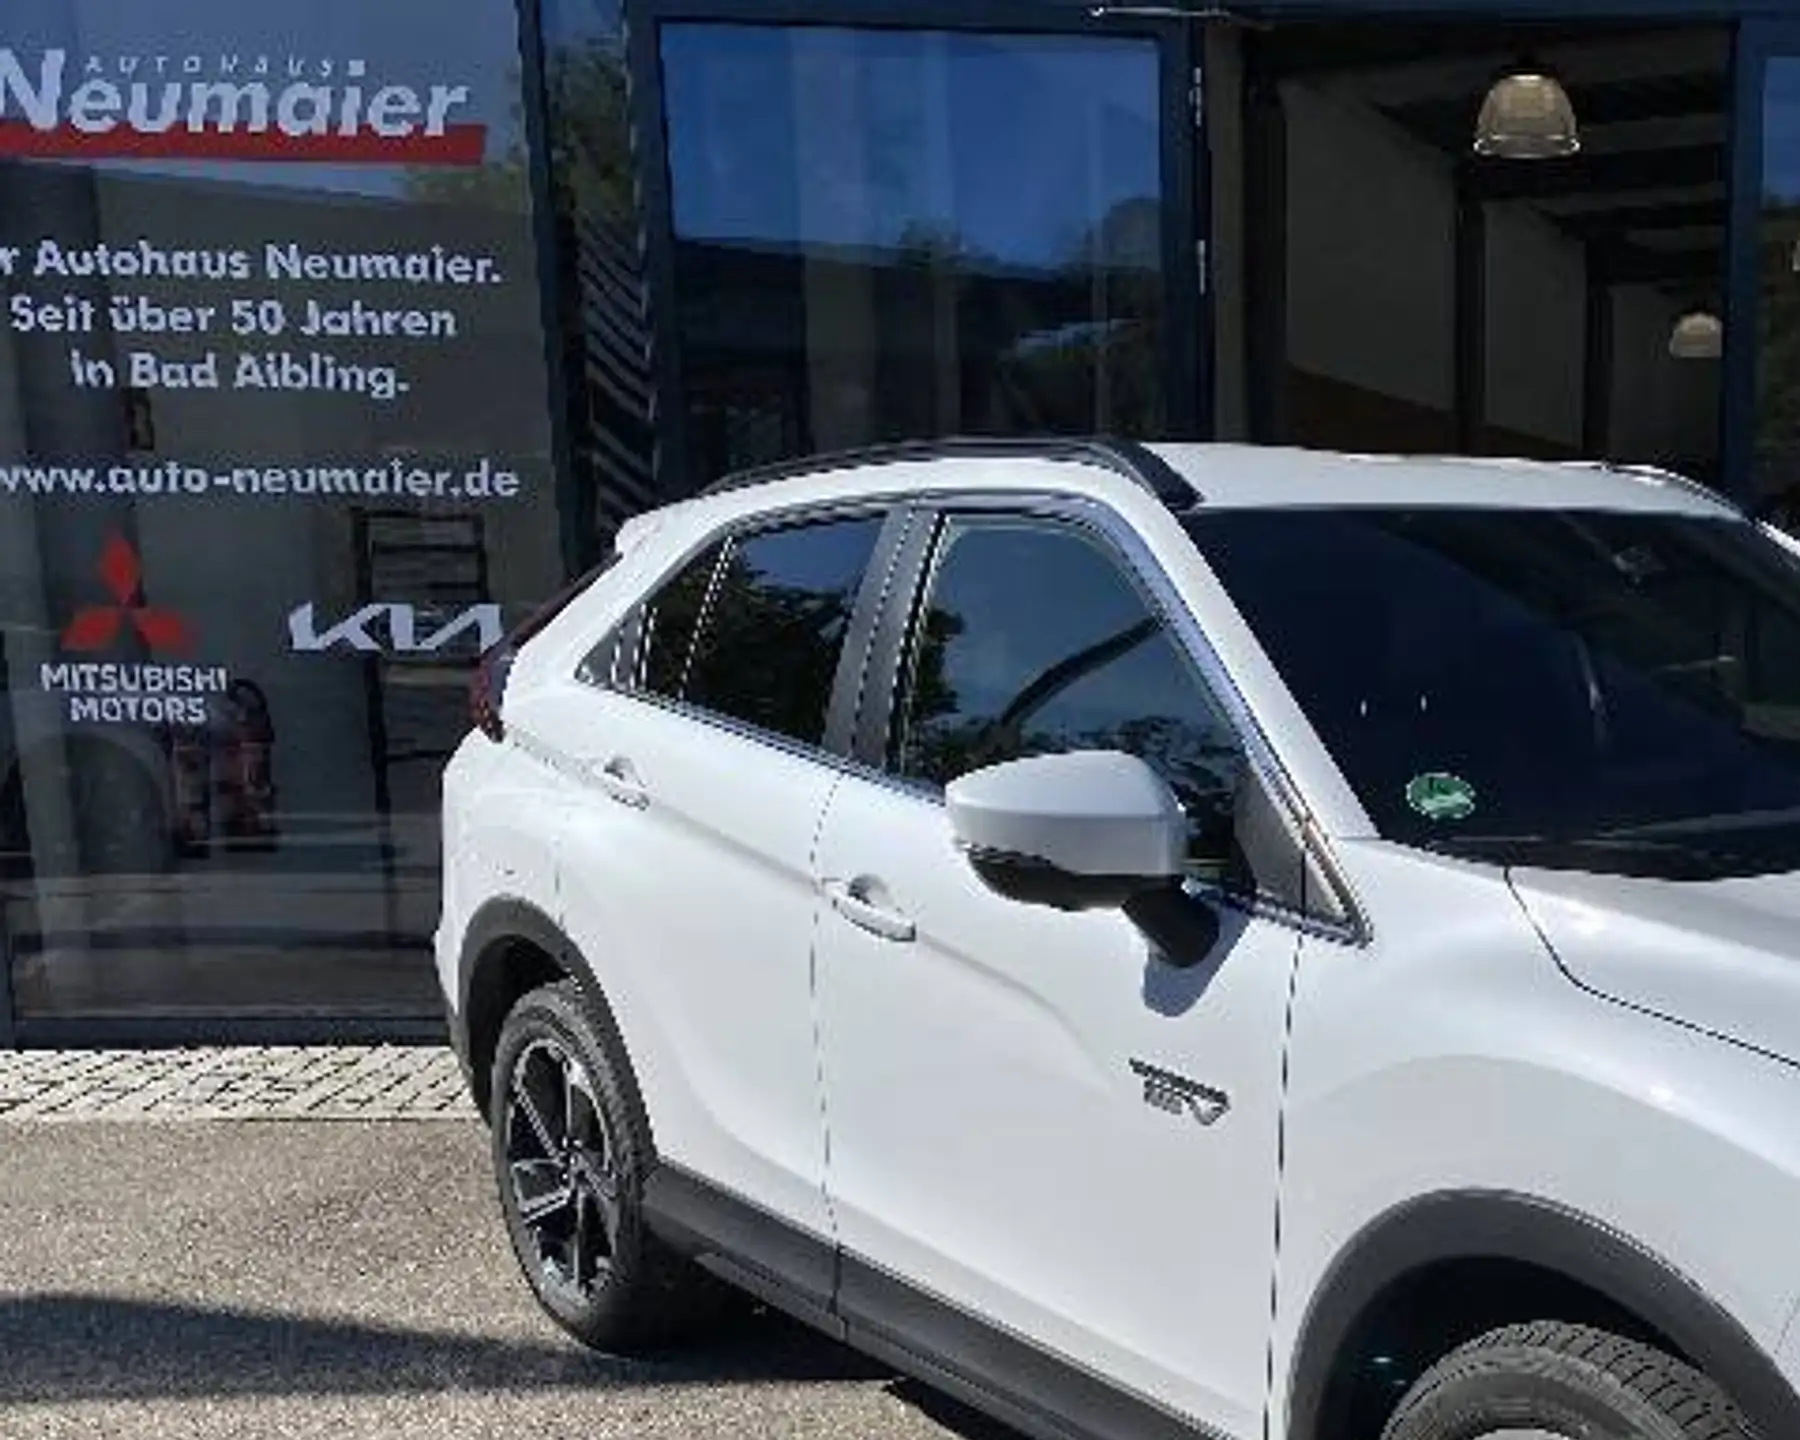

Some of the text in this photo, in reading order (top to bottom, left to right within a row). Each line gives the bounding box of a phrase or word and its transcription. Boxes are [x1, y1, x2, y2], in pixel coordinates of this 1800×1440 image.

[0, 48, 469, 137] Neumaier
[33, 239, 249, 277] Autohaus
[265, 243, 502, 284] Neumaier.
[10, 294, 457, 337] Seit über 50 Jahren
[70, 350, 410, 400] in Bad Aibling.
[289, 601, 504, 654] KIA
[41, 663, 227, 693] MITSUBISHI
[70, 697, 207, 723] MOTORS
